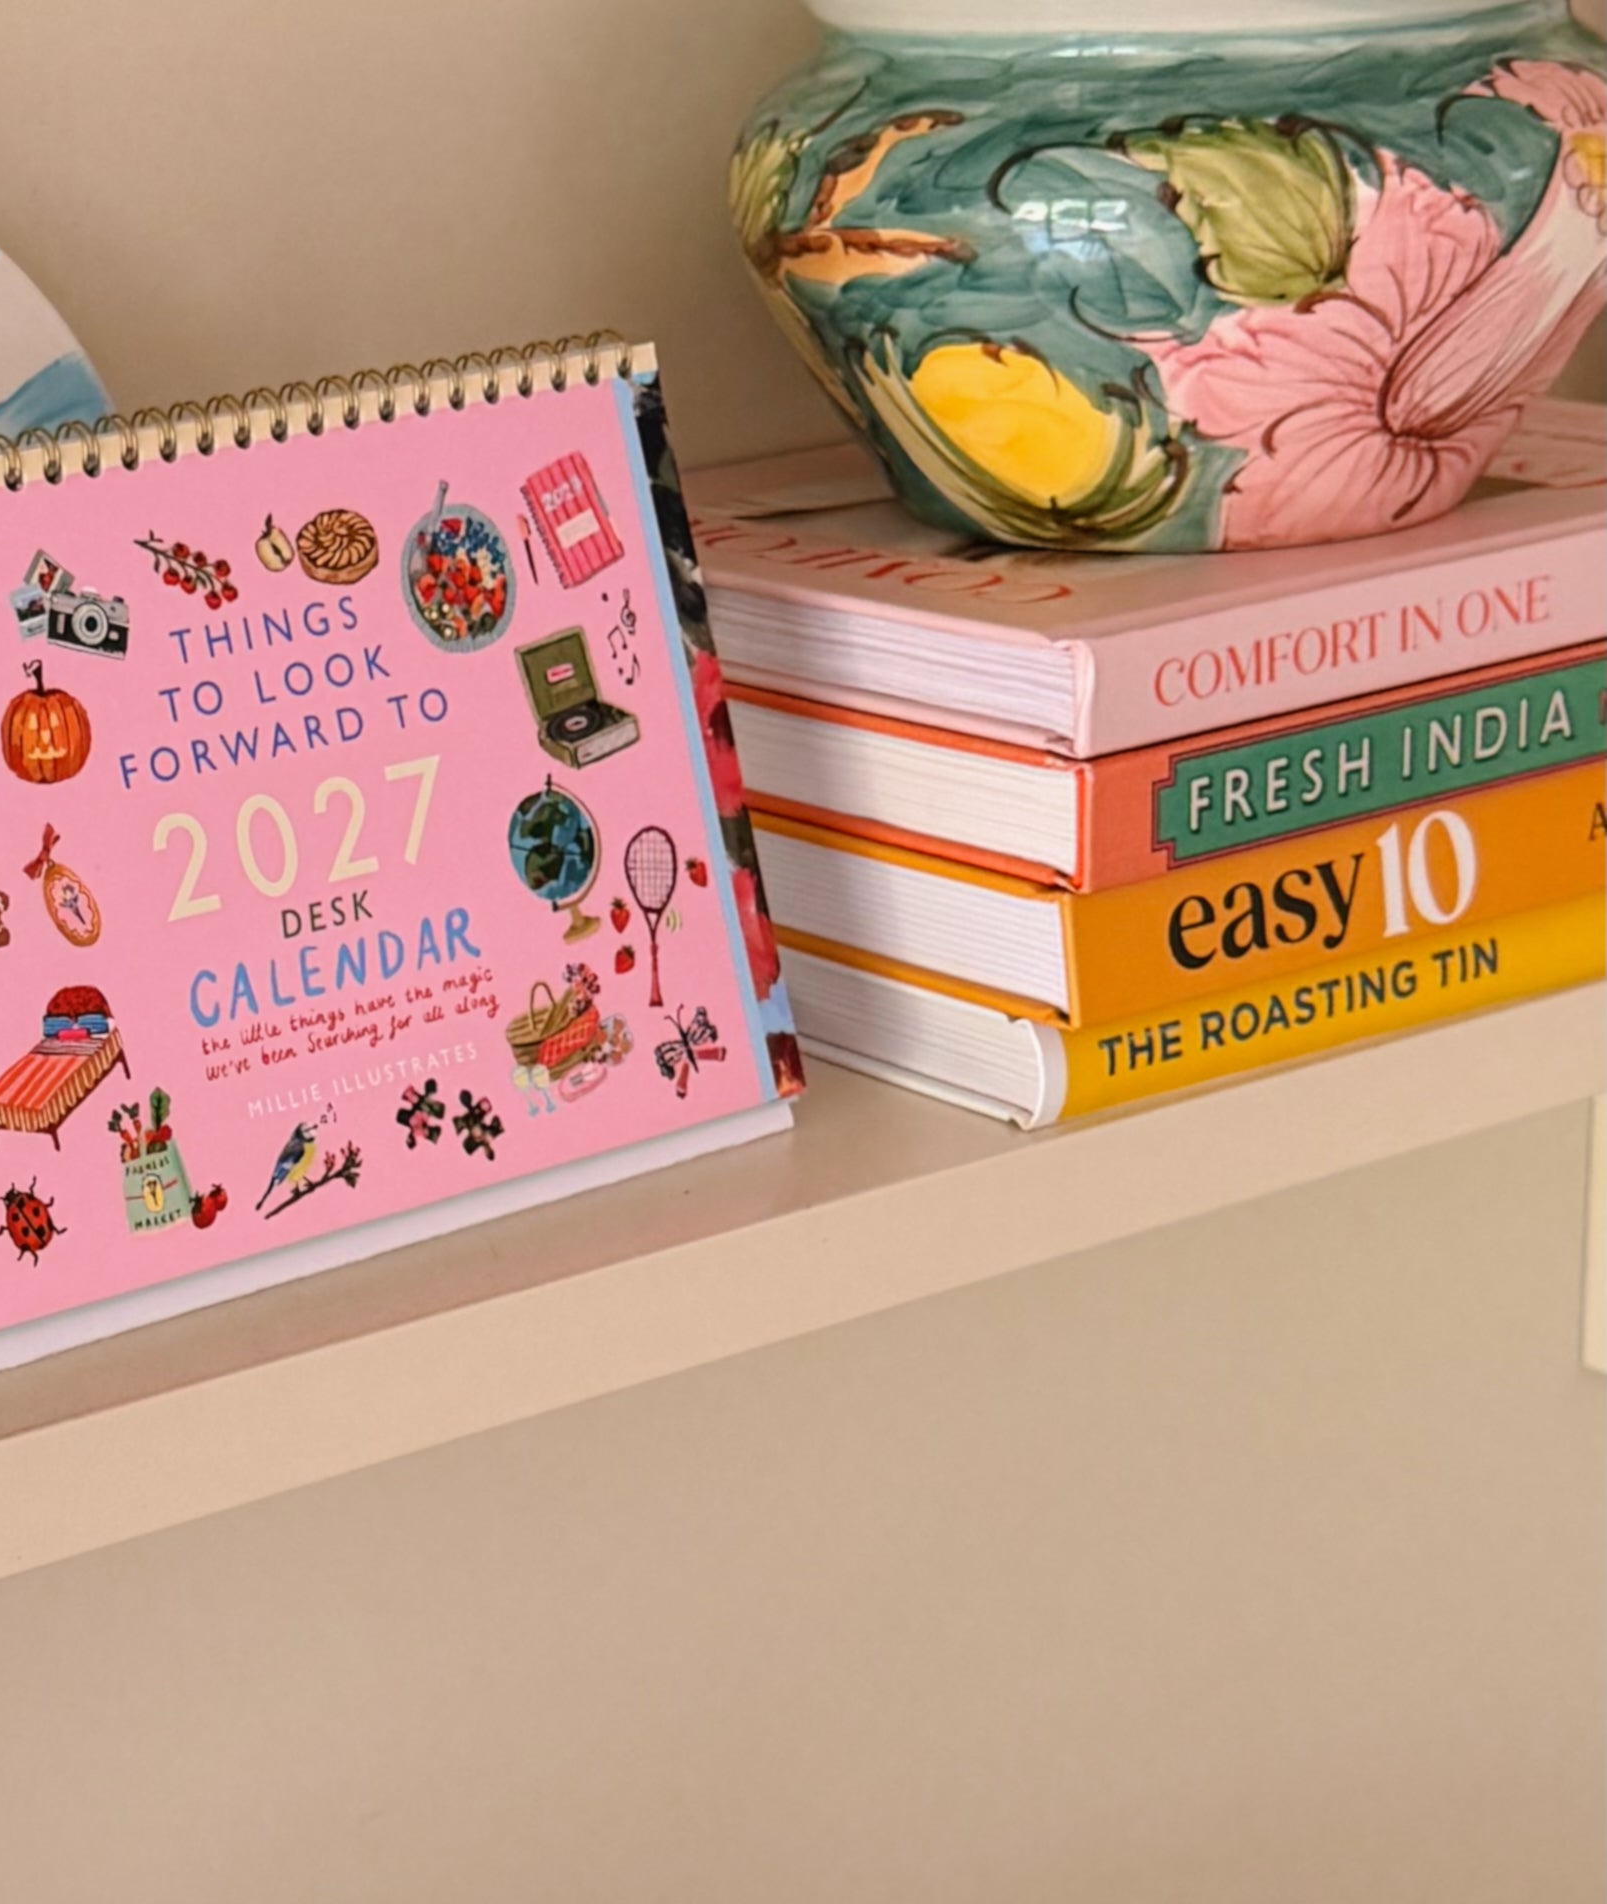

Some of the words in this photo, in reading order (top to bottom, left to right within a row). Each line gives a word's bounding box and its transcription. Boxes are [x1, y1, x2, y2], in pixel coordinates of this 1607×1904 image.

[168, 595, 359, 664] THINGS
[1153, 609, 1386, 708] COMFORT
[1398, 592, 1444, 653] IN
[1456, 574, 1554, 639] ONE
[158, 680, 224, 723] TO
[254, 644, 391, 704] LOOK
[118, 706, 364, 790] FORWARD
[386, 688, 449, 730] TO
[1188, 736, 1372, 833] FRESH
[1400, 688, 1574, 779] INDIA
[151, 753, 441, 923] 2027
[280, 889, 374, 940] DESK
[189, 906, 482, 1028] CALENDAR
[201, 1036, 231, 1056] the
[240, 1021, 282, 1046] little
[289, 1006, 346, 1032] things
[354, 994, 397, 1016] have
[405, 985, 433, 1004] the
[442, 964, 494, 994] magic
[1098, 1019, 1184, 1077] THE
[1200, 960, 1418, 1053] ROASTING
[1431, 938, 1500, 989] TIN
[205, 1057, 251, 1081] we've
[260, 1044, 298, 1066] been
[388, 1014, 413, 1041] for
[423, 1005, 445, 1024] all
[454, 993, 501, 1019] along
[246, 1082, 322, 1119] MILLIE
[332, 1041, 479, 1097] ILLUSTRATES
